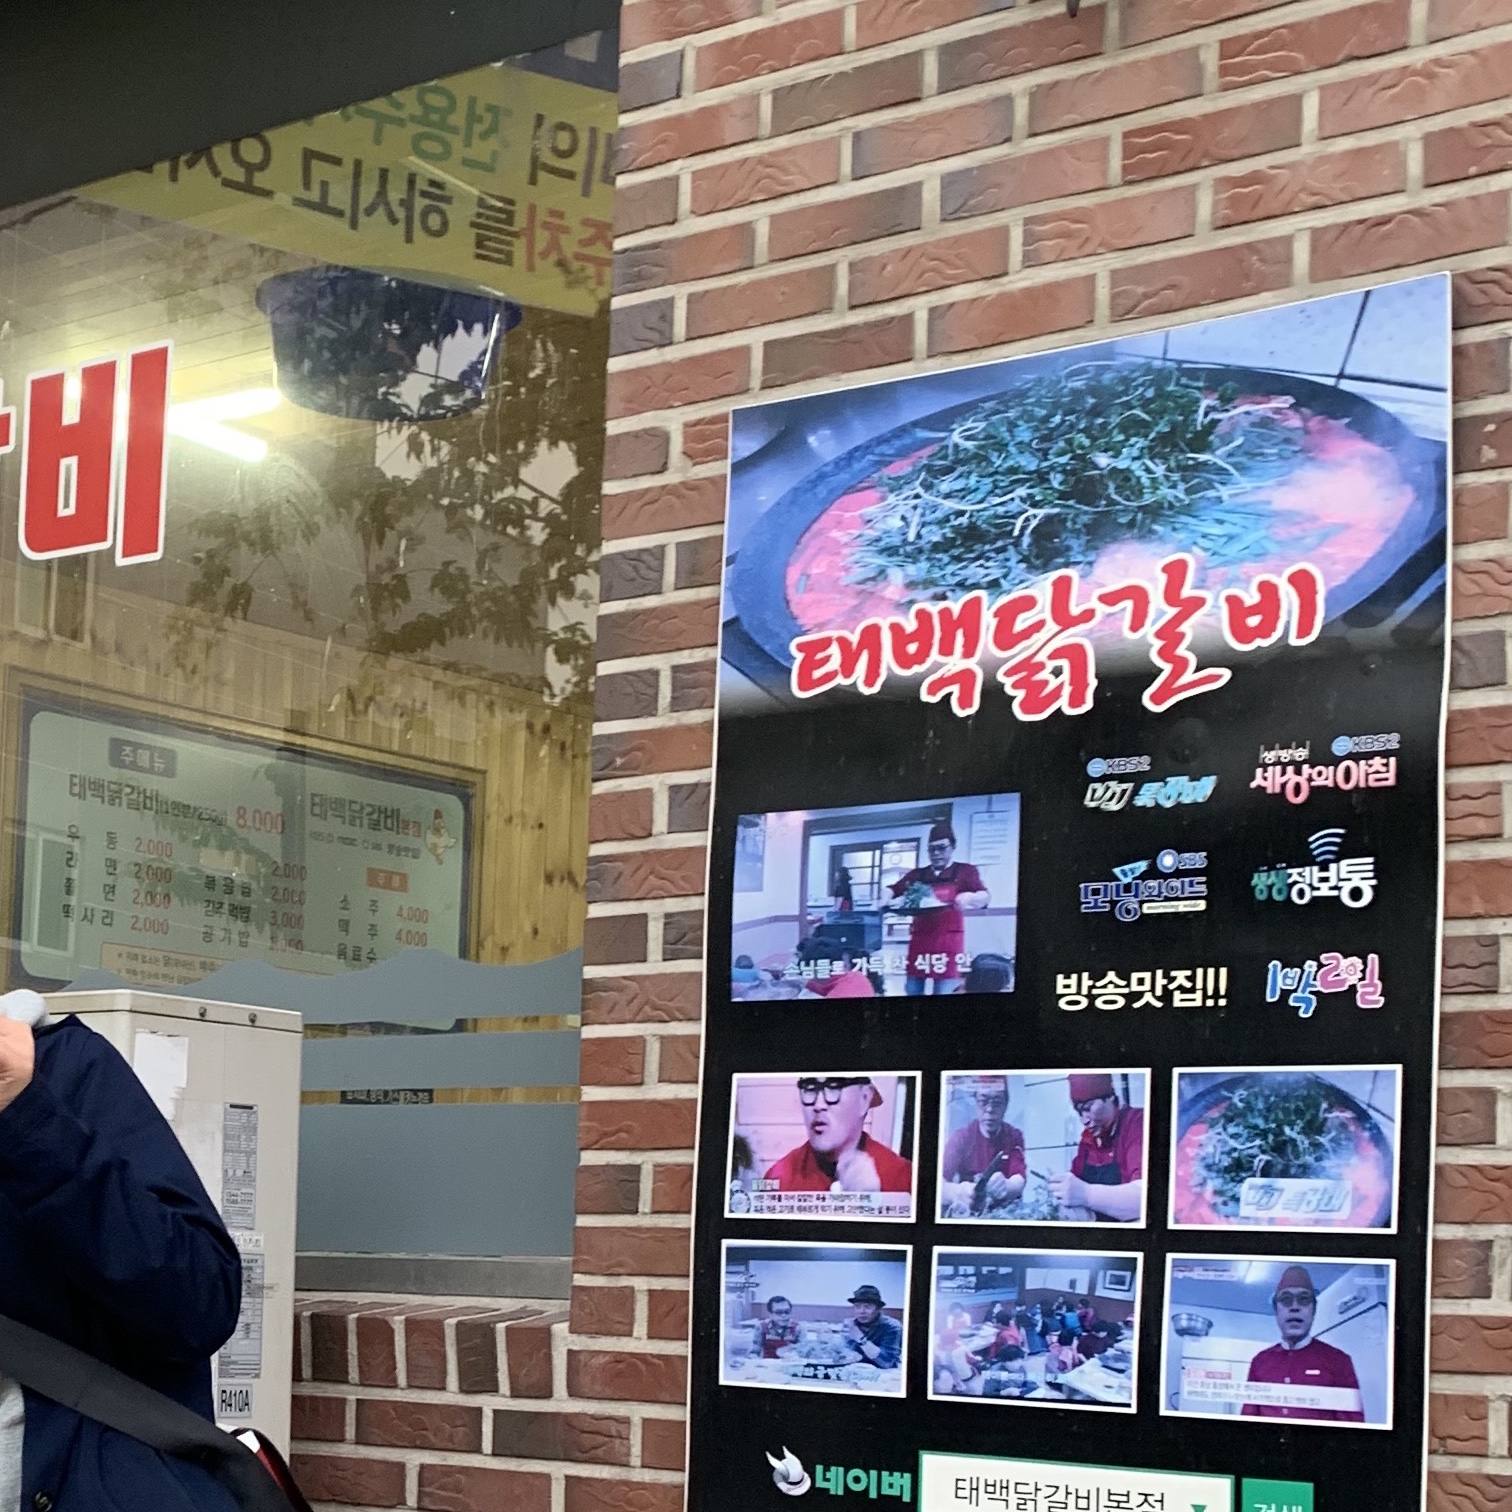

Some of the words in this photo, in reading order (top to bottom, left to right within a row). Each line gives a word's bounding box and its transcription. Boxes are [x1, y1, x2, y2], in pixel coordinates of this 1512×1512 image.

[791, 553, 1324, 721] 태백닭갈비
[1351, 733, 1401, 752] KBS2
[1079, 877, 1208, 921] 모닝와이드
[783, 958, 845, 980] 손님들로
[914, 953, 949, 974] 식당
[954, 953, 973, 973] 안
[1266, 952, 1385, 1018] 1박2일
[1055, 967, 1228, 1010] 방송맛집!!
[220, 1389, 250, 1413] R410A
[815, 1463, 912, 1503] 네이버
